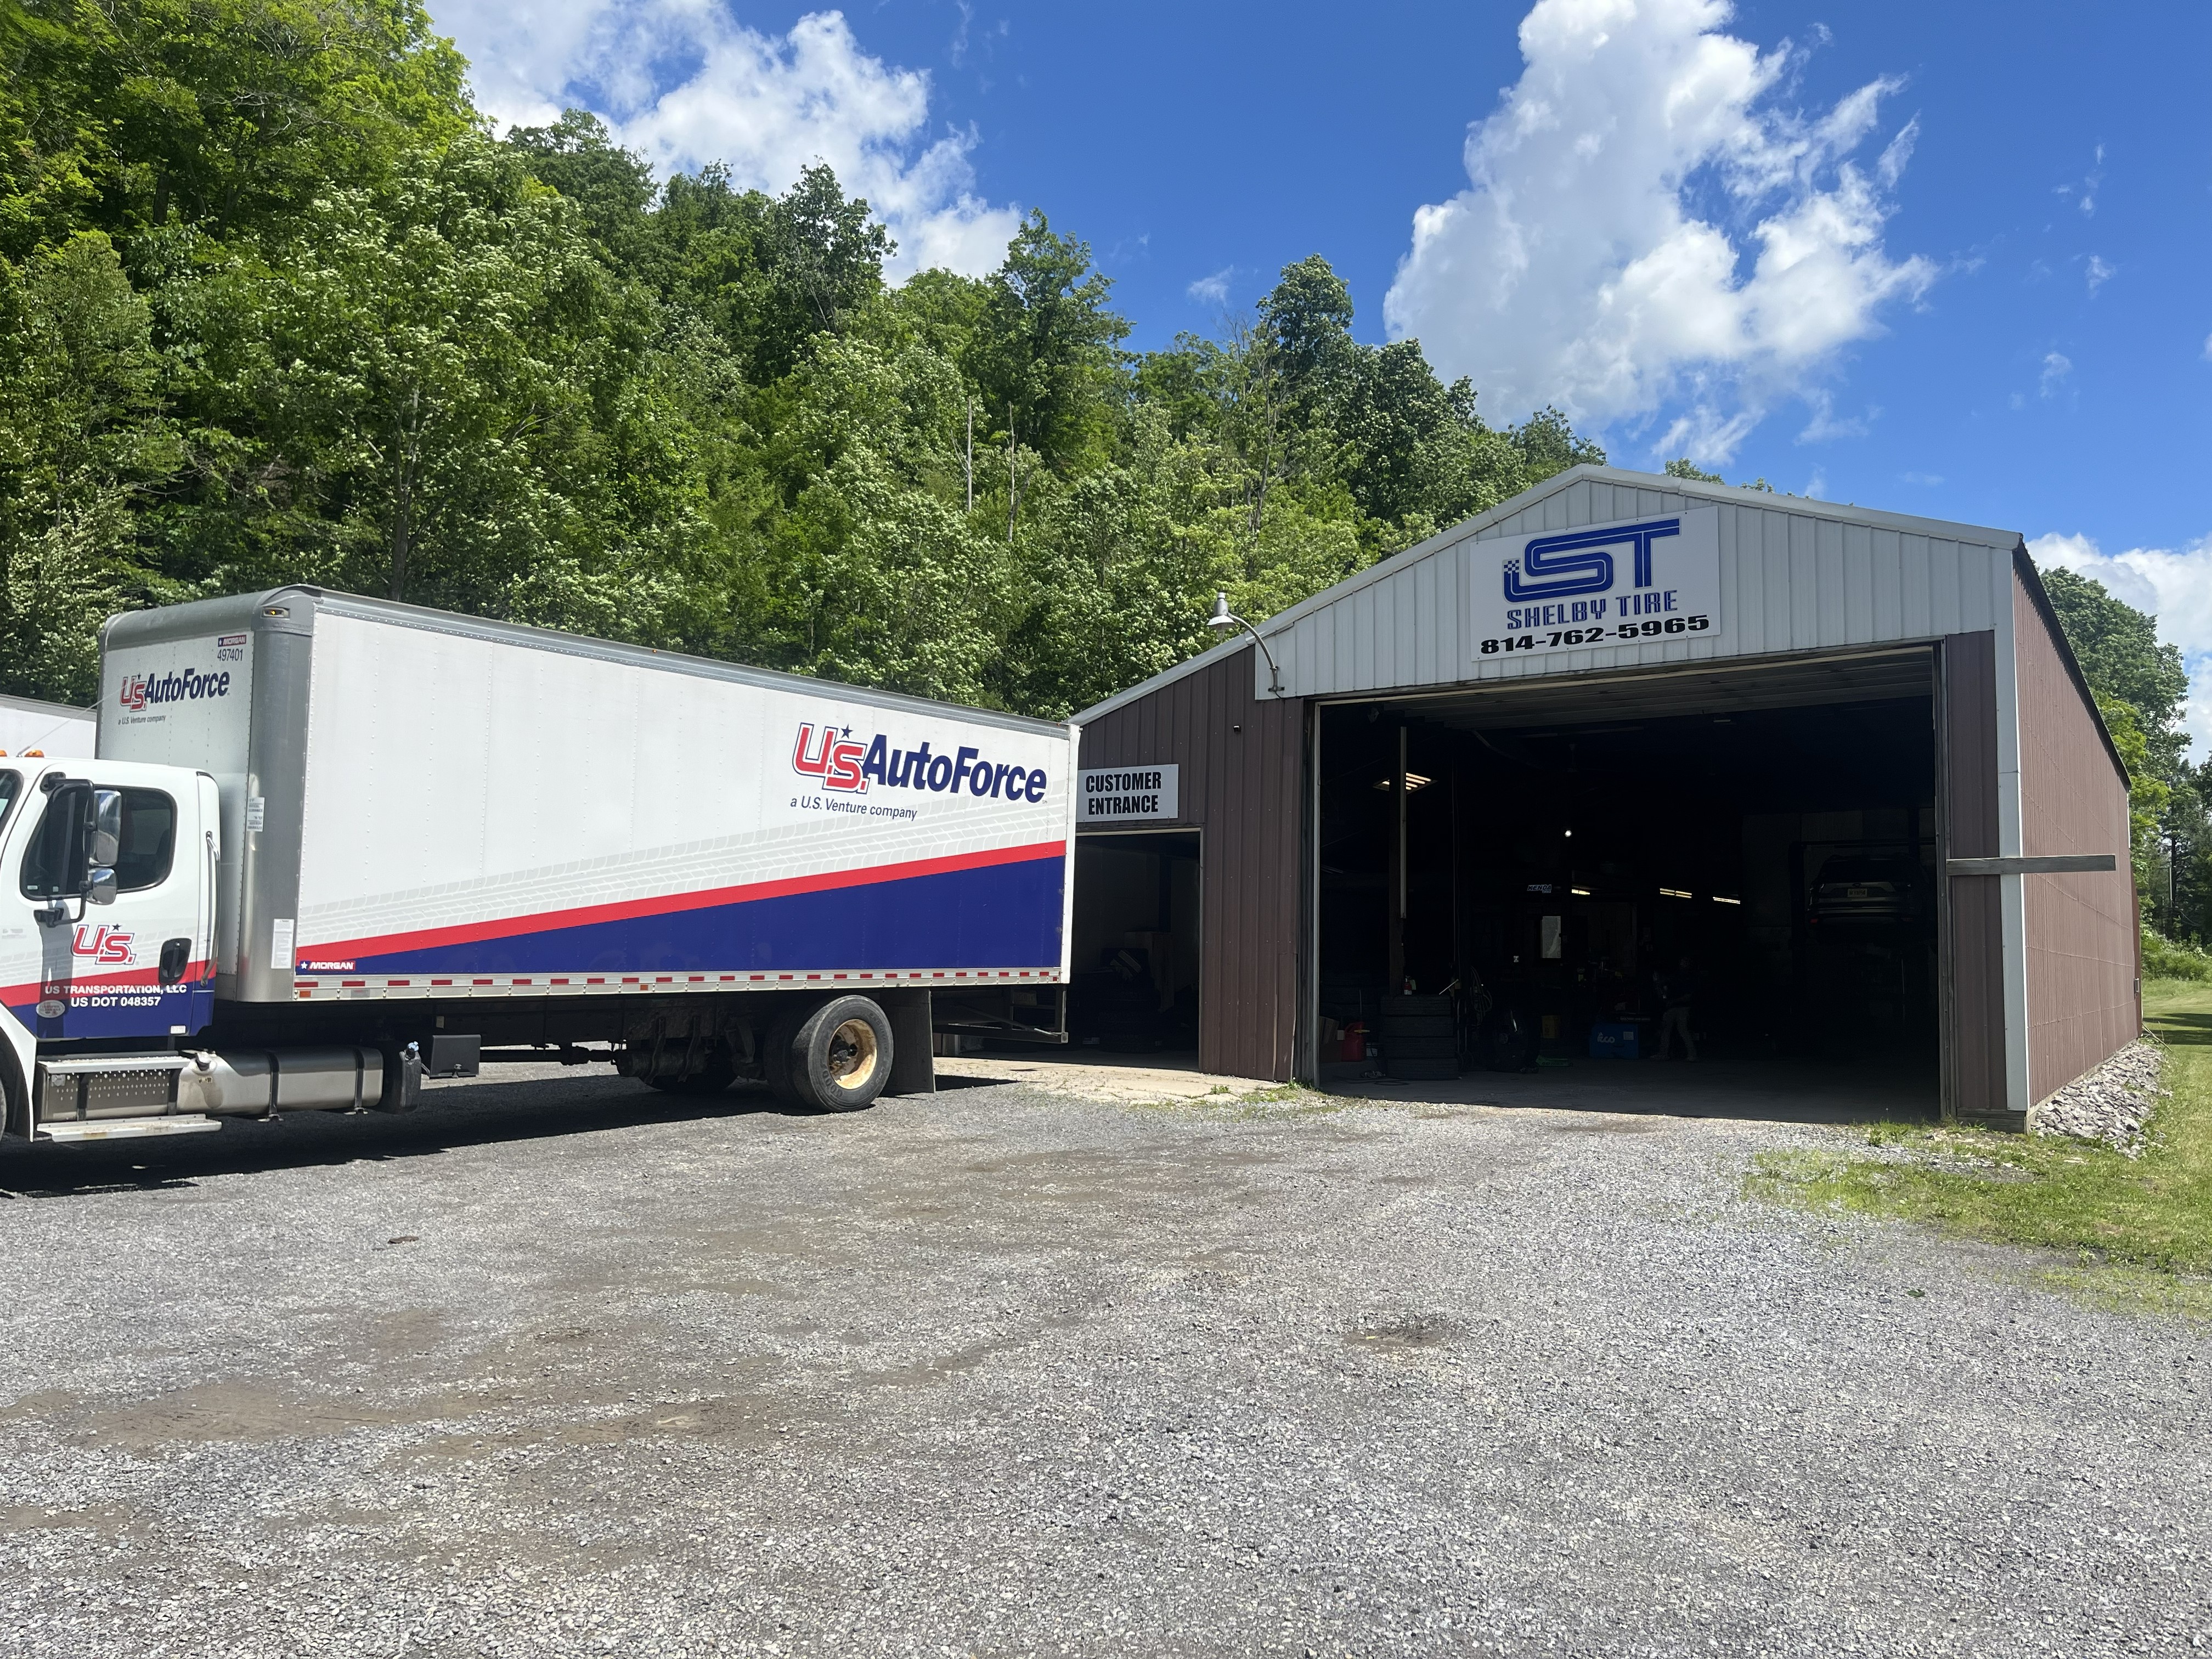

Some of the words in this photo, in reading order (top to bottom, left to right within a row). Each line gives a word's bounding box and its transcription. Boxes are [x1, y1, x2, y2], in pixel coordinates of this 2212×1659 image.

[1506, 598, 1606, 630] SHELBY
[1615, 590, 1678, 617] TIRE
[223, 636, 246, 645] MORGAN
[1481, 614, 1709, 654] 814-762-5965
[217, 648, 243, 662] 497401
[144, 668, 229, 703] AutoForce
[130, 715, 146, 724] Venture
[147, 715, 166, 725] company
[861, 734, 1046, 803] AutoForce
[1085, 771, 1161, 793] CUSTOMER
[790, 797, 797, 808] a
[801, 795, 822, 810] U.S.
[826, 798, 867, 815] Venture
[870, 805, 918, 822] company
[1088, 795, 1159, 815] ENTRANCE
[309, 961, 353, 970] MORGAN
[44, 985, 60, 994] US
[64, 985, 163, 995] TRANSPORTATION,
[166, 984, 187, 994] LLC
[71, 997, 88, 1007] US
[91, 997, 118, 1007] DOT
[120, 996, 161, 1007] 048357
